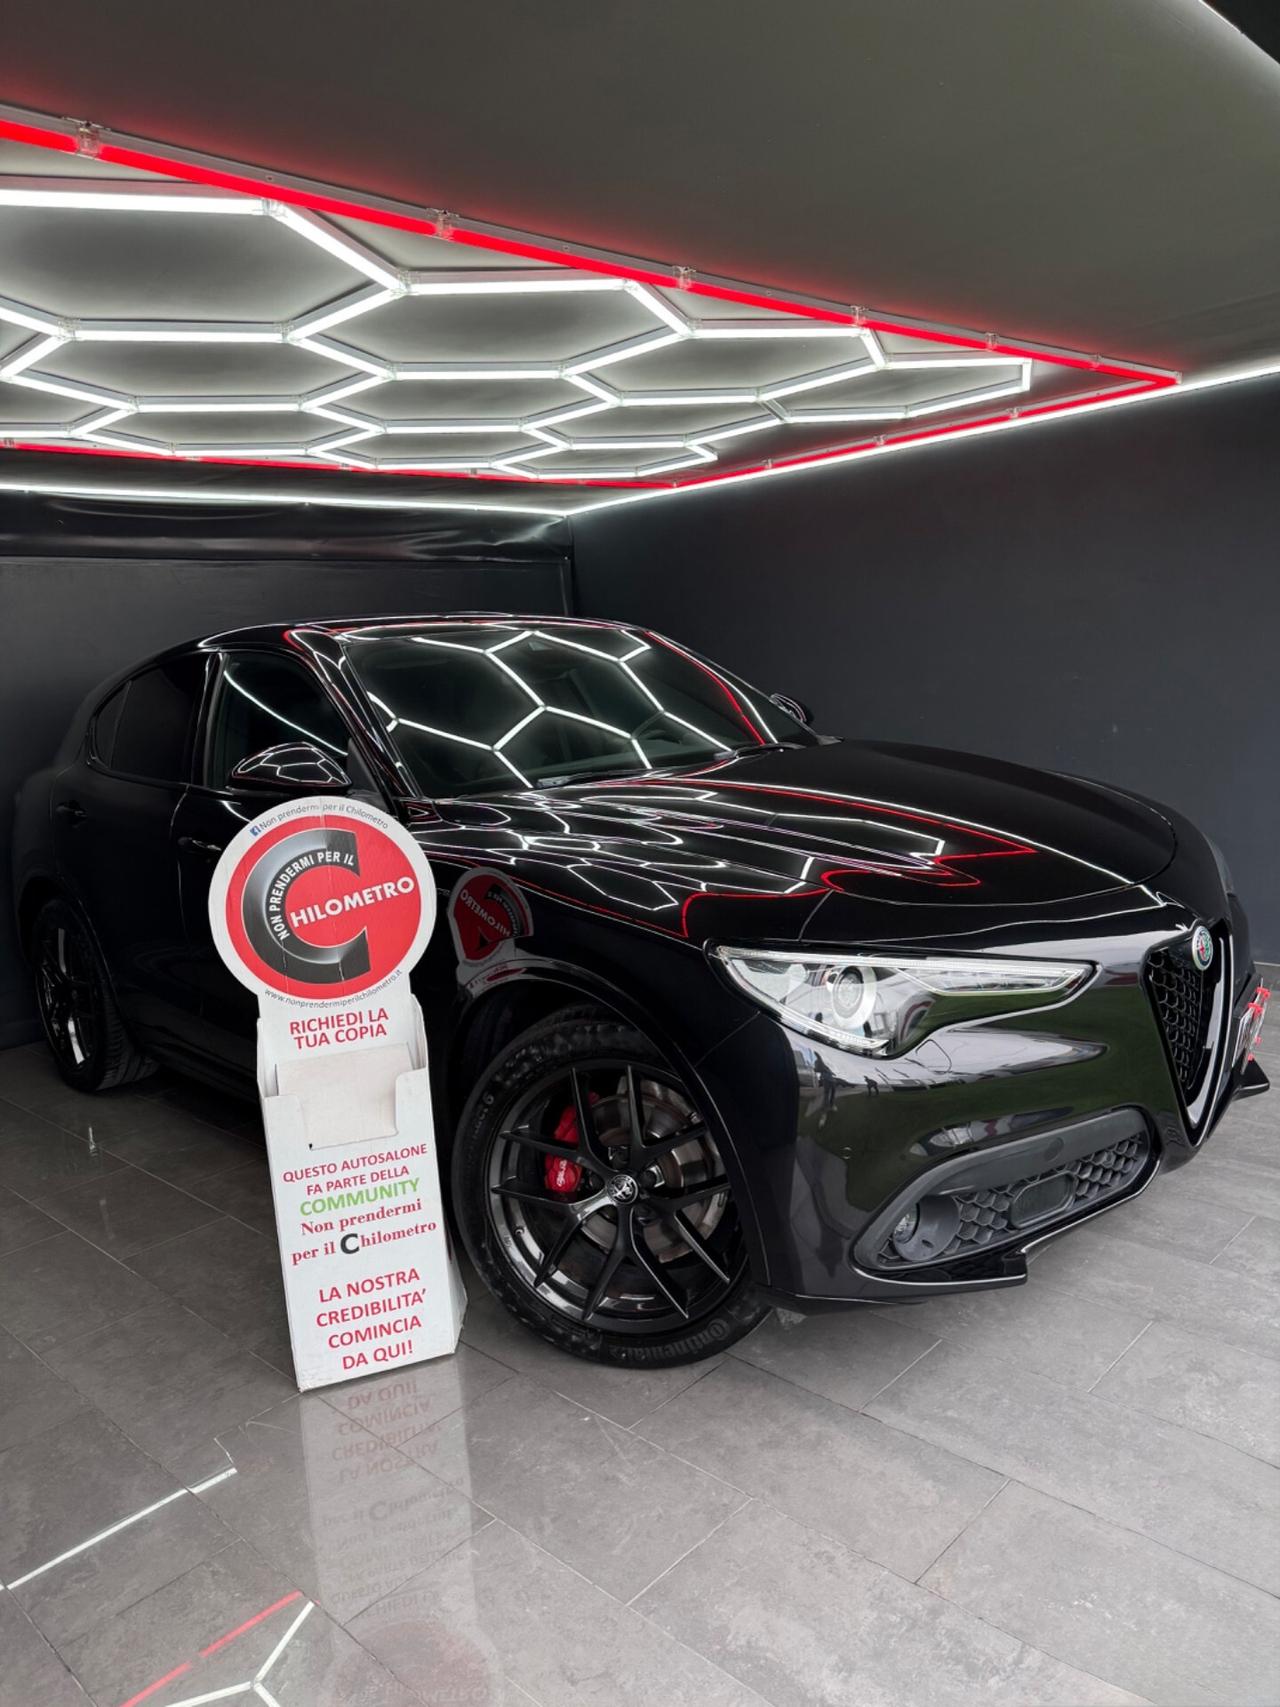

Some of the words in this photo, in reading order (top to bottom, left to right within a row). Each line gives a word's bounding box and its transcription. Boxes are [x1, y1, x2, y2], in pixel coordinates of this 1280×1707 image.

[260, 817, 277, 830] Non
[322, 804, 337, 812] per
[339, 804, 345, 812] il
[345, 805, 388, 829] Chilometro
[317, 851, 341, 863] PER
[343, 853, 355, 866] IL
[269, 854, 314, 911] PRENDERMI
[269, 915, 290, 940] NON
[289, 1011, 363, 1035] RICHIEDI
[368, 1007, 389, 1022] LA
[294, 1032, 330, 1049] TUA
[334, 1023, 387, 1043] COPIA
[283, 1163, 337, 1183] QUESTO
[341, 1143, 428, 1172] AUTOSALONE
[306, 1183, 323, 1196] FA
[326, 1174, 367, 1192] PARTE
[370, 1165, 410, 1183] DELLA
[300, 1178, 420, 1216] COMMUNITY
[301, 1220, 334, 1235] Non
[339, 1198, 422, 1232] prendermi
[292, 1248, 319, 1266] per
[324, 1241, 337, 1257] il
[340, 1222, 437, 1255] Chilometro
[319, 1286, 342, 1303] LA
[346, 1267, 420, 1297] NOSTRA
[328, 1315, 422, 1348] COMINCIA
[343, 1352, 369, 1370] DA
[373, 1340, 413, 1362] QUI!
